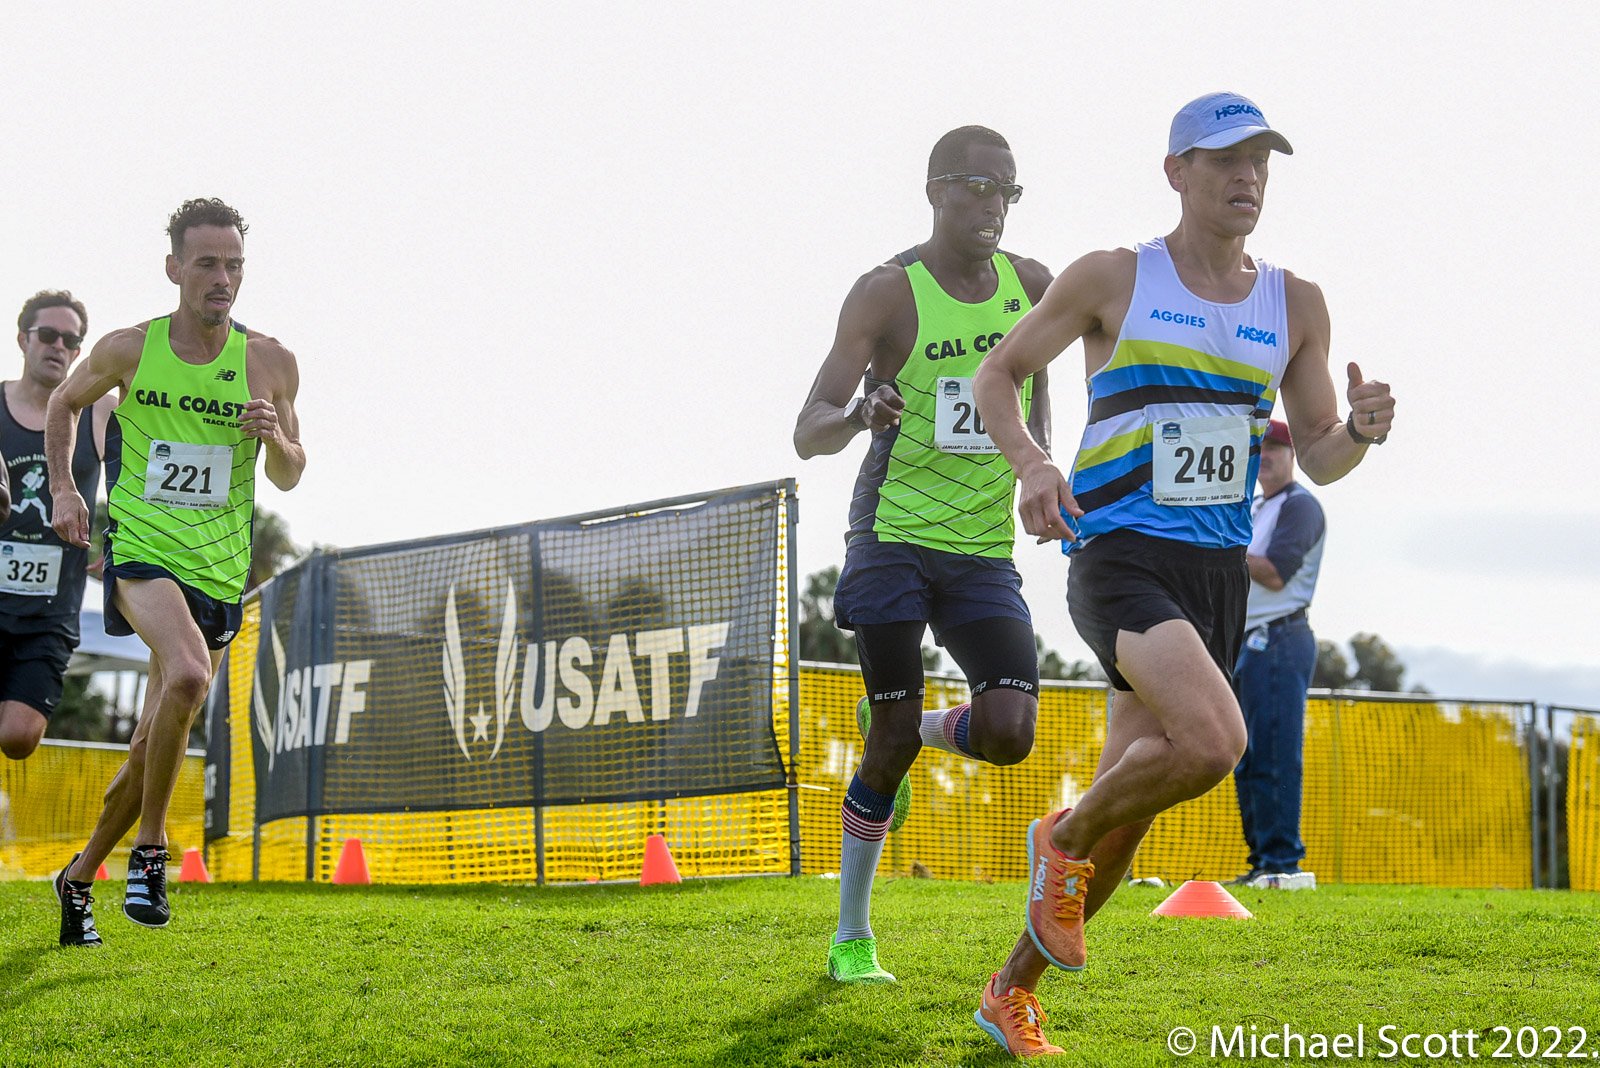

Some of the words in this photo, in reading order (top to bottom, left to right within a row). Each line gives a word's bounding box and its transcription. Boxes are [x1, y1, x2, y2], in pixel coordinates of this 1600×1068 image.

[1150, 309, 1206, 328] AGGIES
[925, 338, 967, 361] CAL
[973, 332, 1004, 352] CO
[1236, 324, 1277, 347] HOKA
[135, 389, 171, 408] CAL
[179, 395, 245, 418] COAST
[202, 418, 226, 427] TRACK
[1174, 445, 1235, 483] 248
[160, 463, 212, 494] 221
[7, 560, 49, 583] 325
[520, 621, 731, 732] USATF
[1012, 679, 1033, 691] cep
[884, 689, 906, 700] cep
[1032, 855, 1048, 901] HOKA
